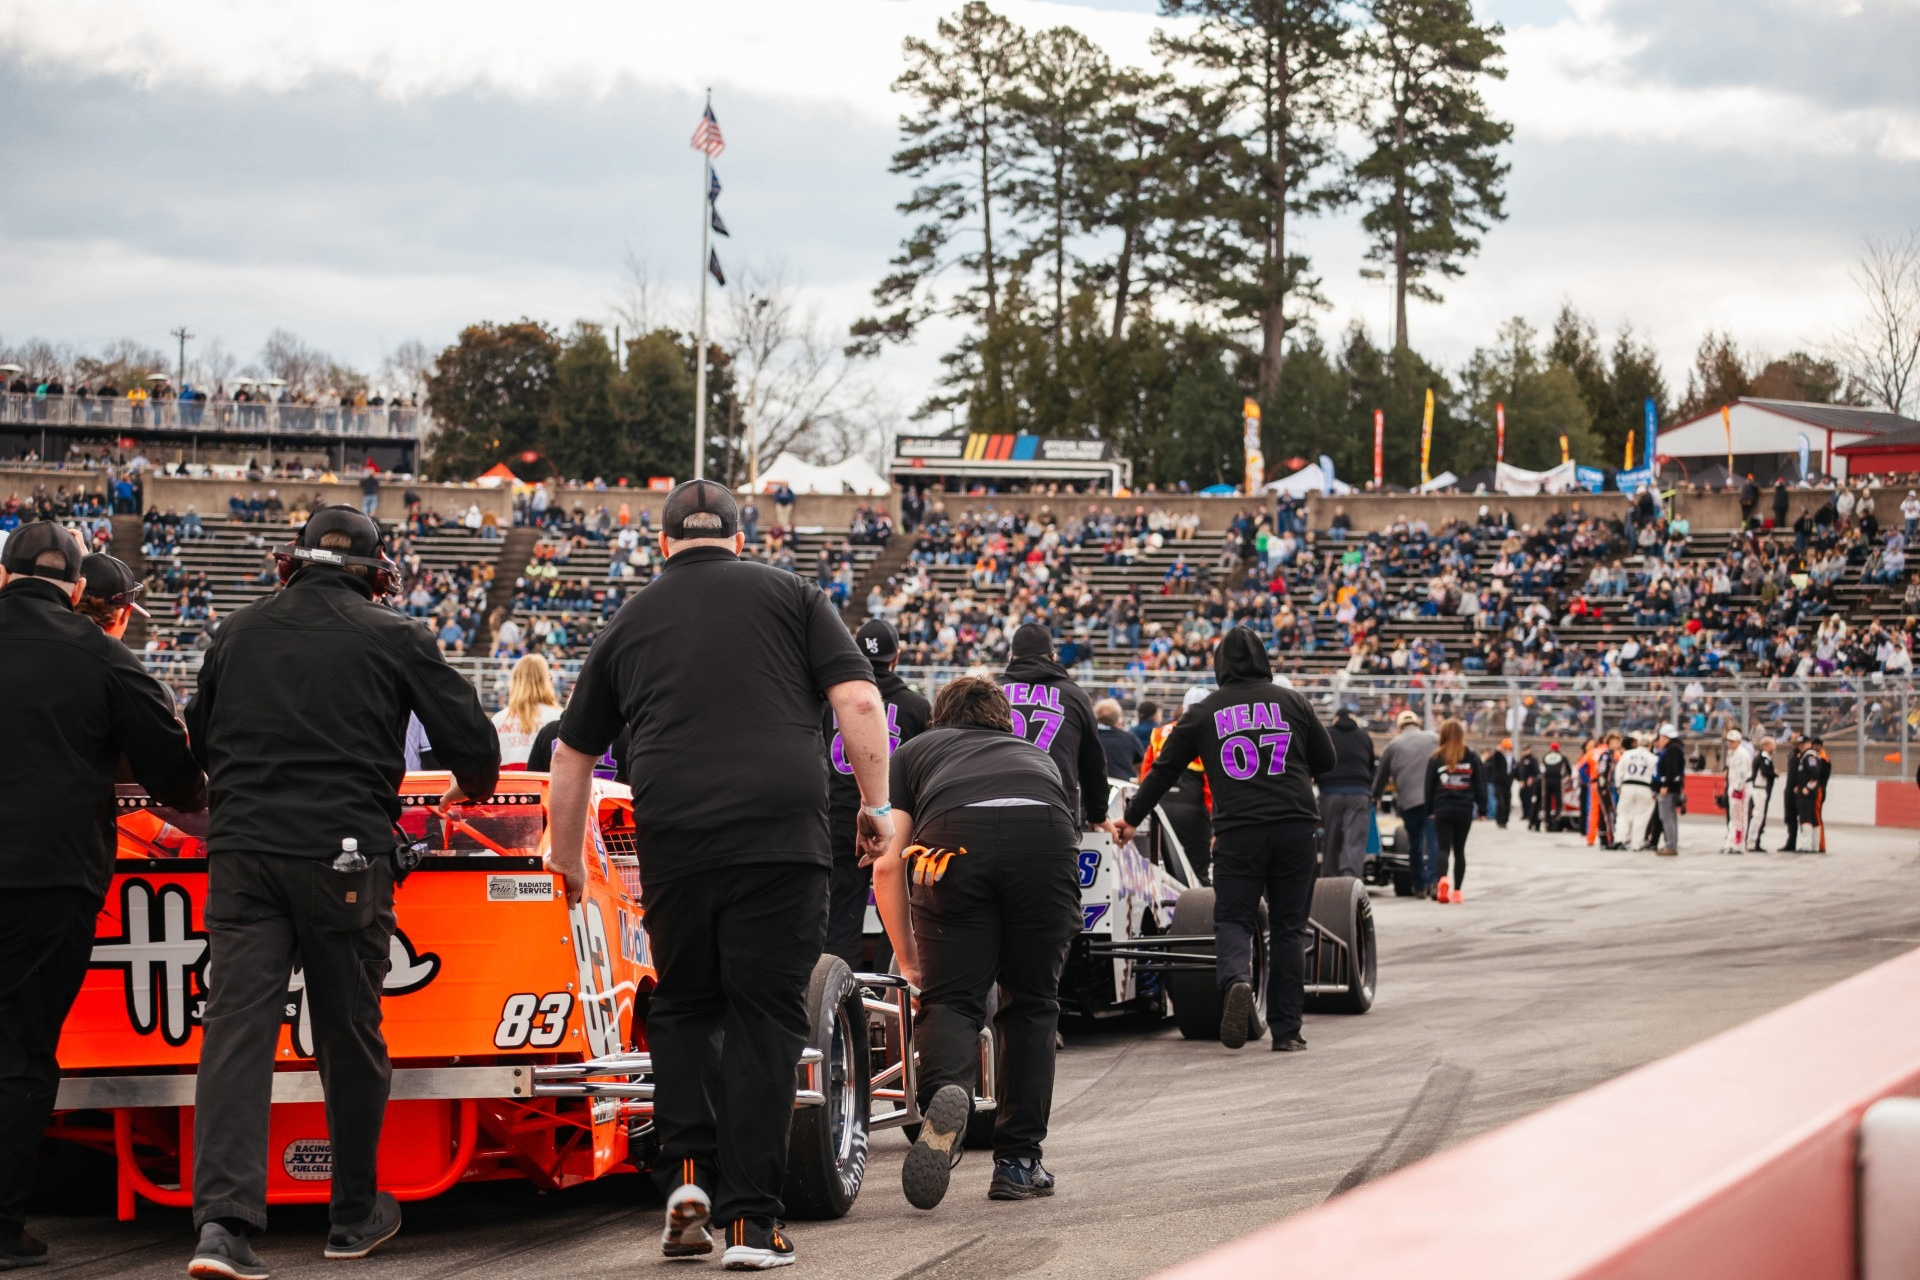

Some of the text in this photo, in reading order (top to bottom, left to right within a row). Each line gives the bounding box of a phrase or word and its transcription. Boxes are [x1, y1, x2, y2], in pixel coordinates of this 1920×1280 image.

[1214, 702, 1290, 740] NEAL
[1220, 732, 1292, 780] 07
[1628, 763, 1648, 776] 07
[617, 907, 650, 969] Mobil
[569, 897, 621, 1059] 83
[493, 991, 575, 1050] 83
